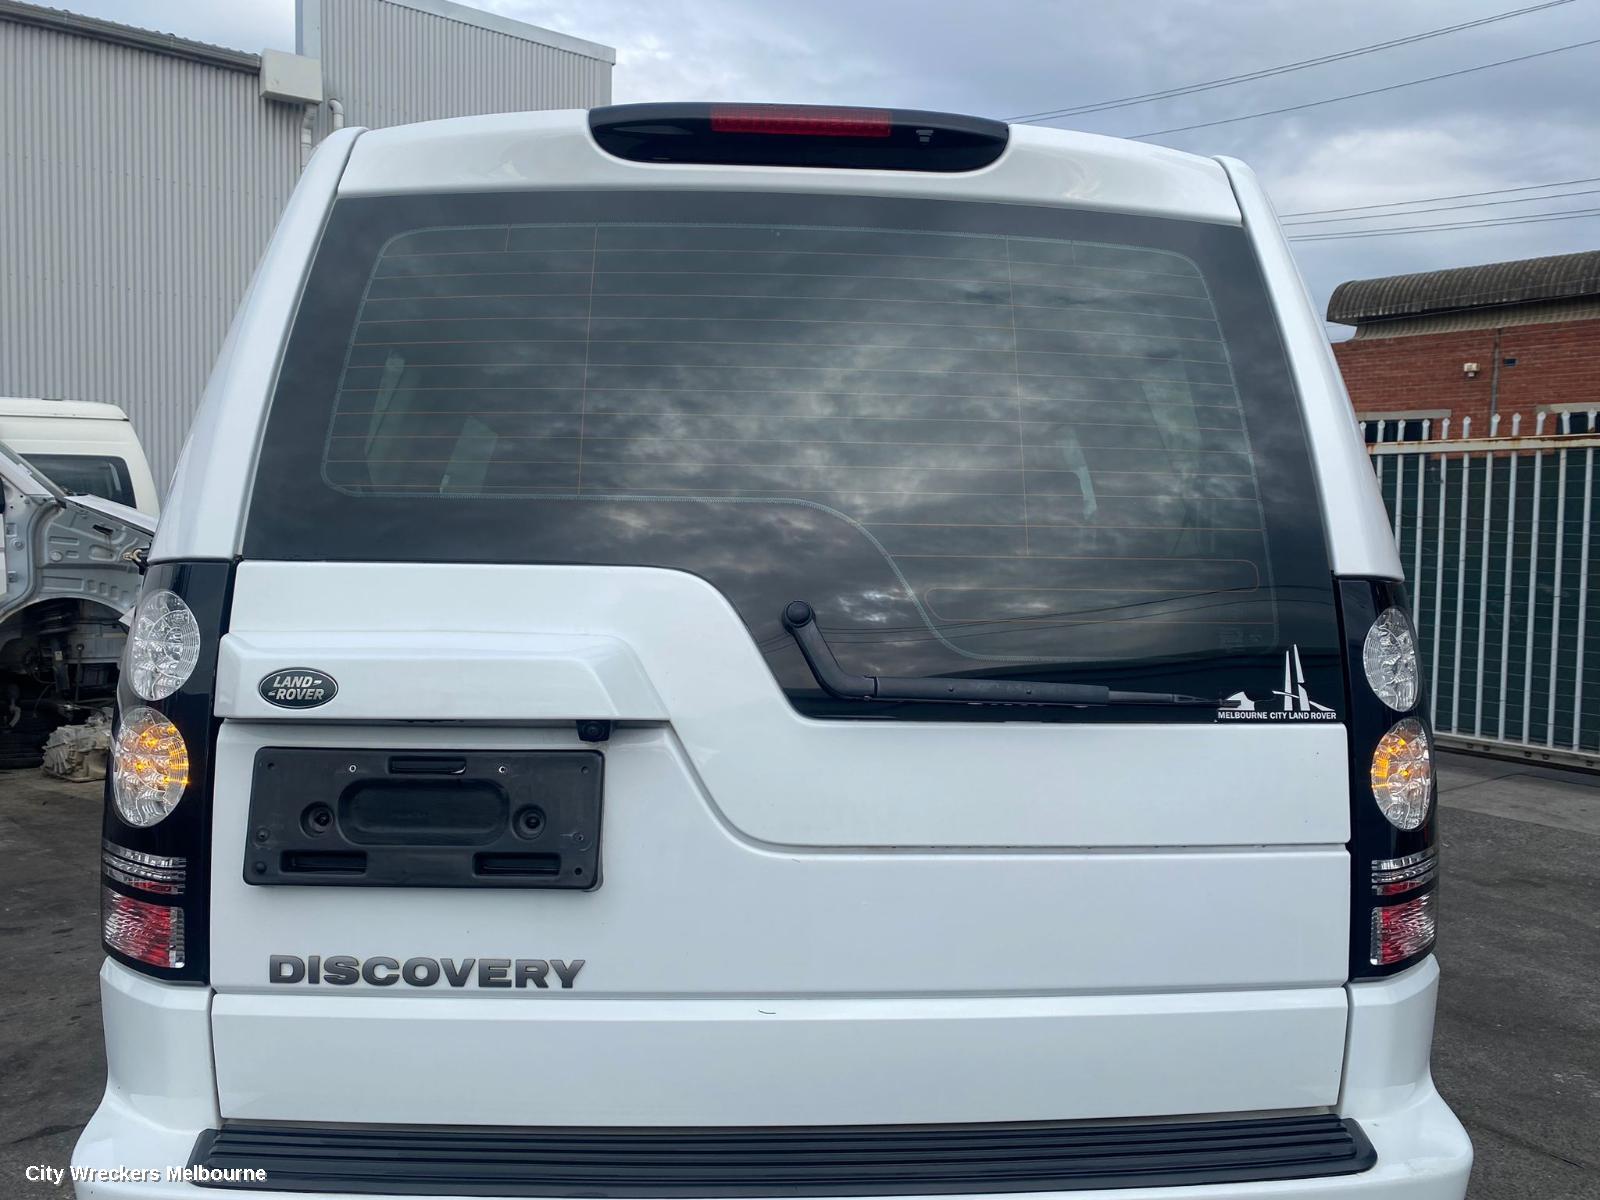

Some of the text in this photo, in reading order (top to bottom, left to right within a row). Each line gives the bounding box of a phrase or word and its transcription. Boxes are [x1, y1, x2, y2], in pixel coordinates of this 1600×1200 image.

[1217, 711, 1268, 719] MELBOURNE
[1310, 712, 1337, 720] ROVER
[269, 954, 586, 989] DISCOVERY
